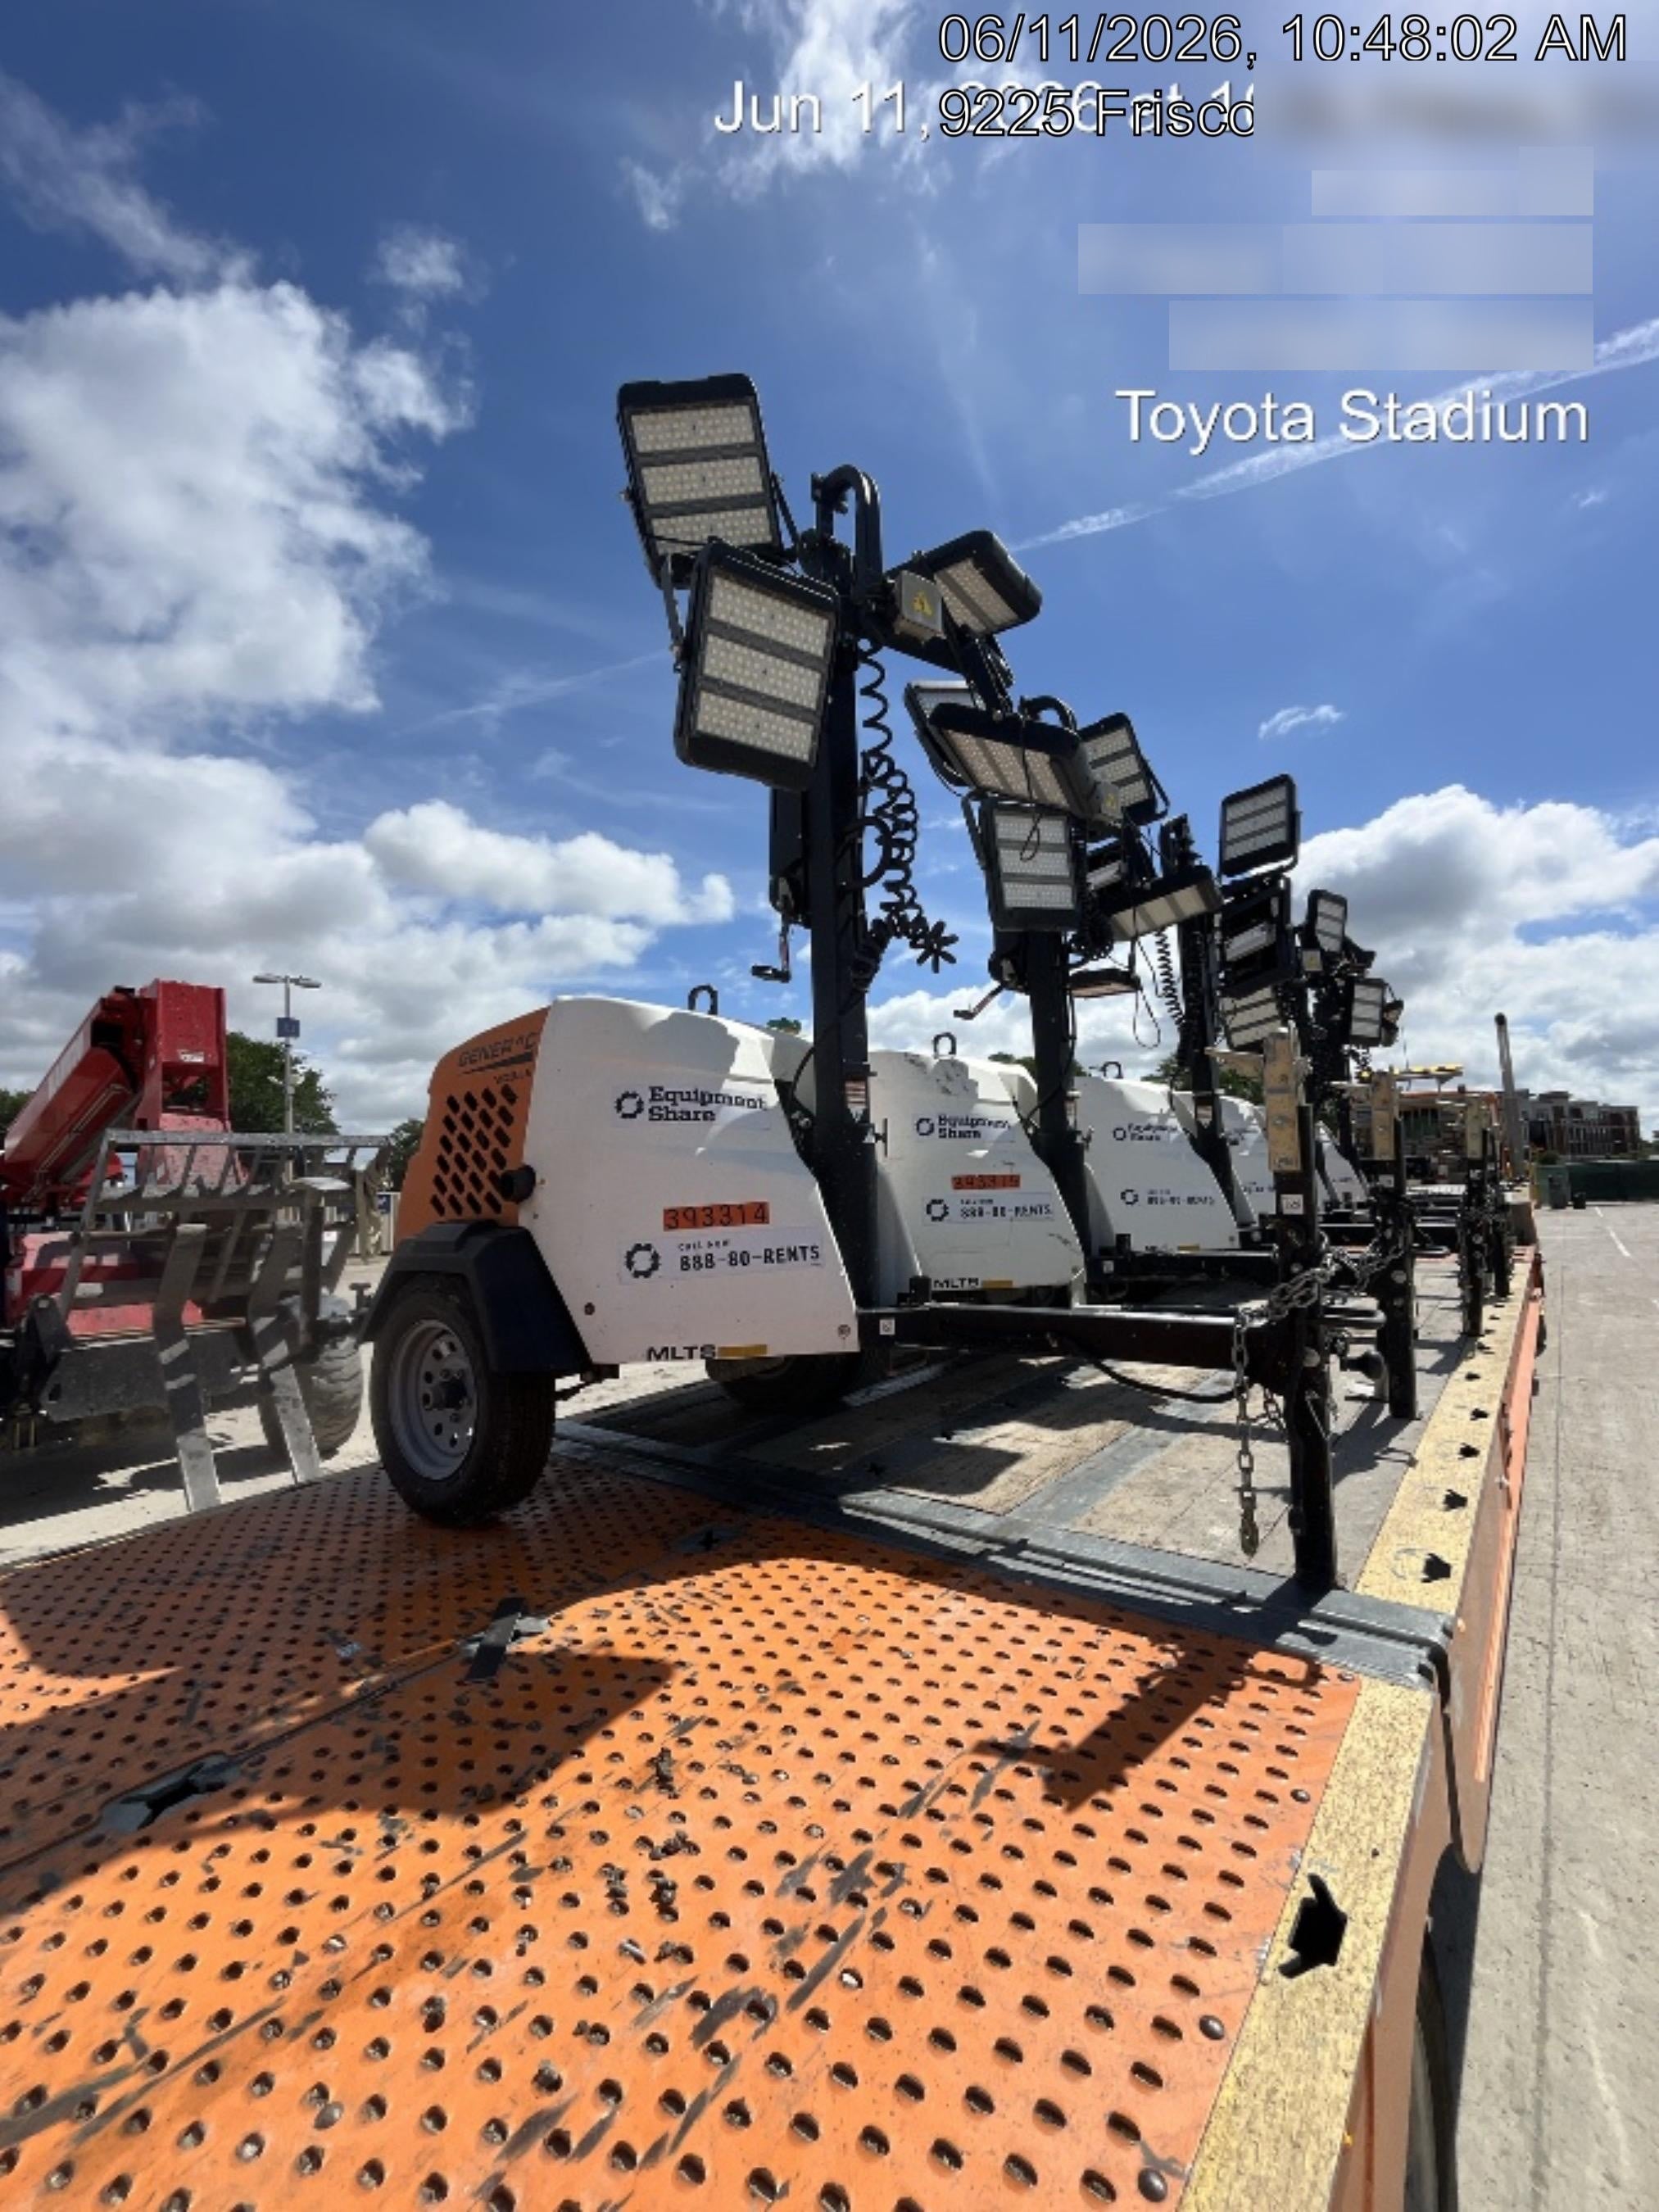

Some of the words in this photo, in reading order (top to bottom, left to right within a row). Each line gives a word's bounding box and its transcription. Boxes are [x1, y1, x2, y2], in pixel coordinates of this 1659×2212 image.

[648, 1086, 767, 1110] Equipment
[648, 1106, 715, 1122] Share
[664, 1203, 768, 1230] 393314
[680, 1245, 819, 1271] 888-80-RENTS
[646, 1344, 715, 1362] MLTS
